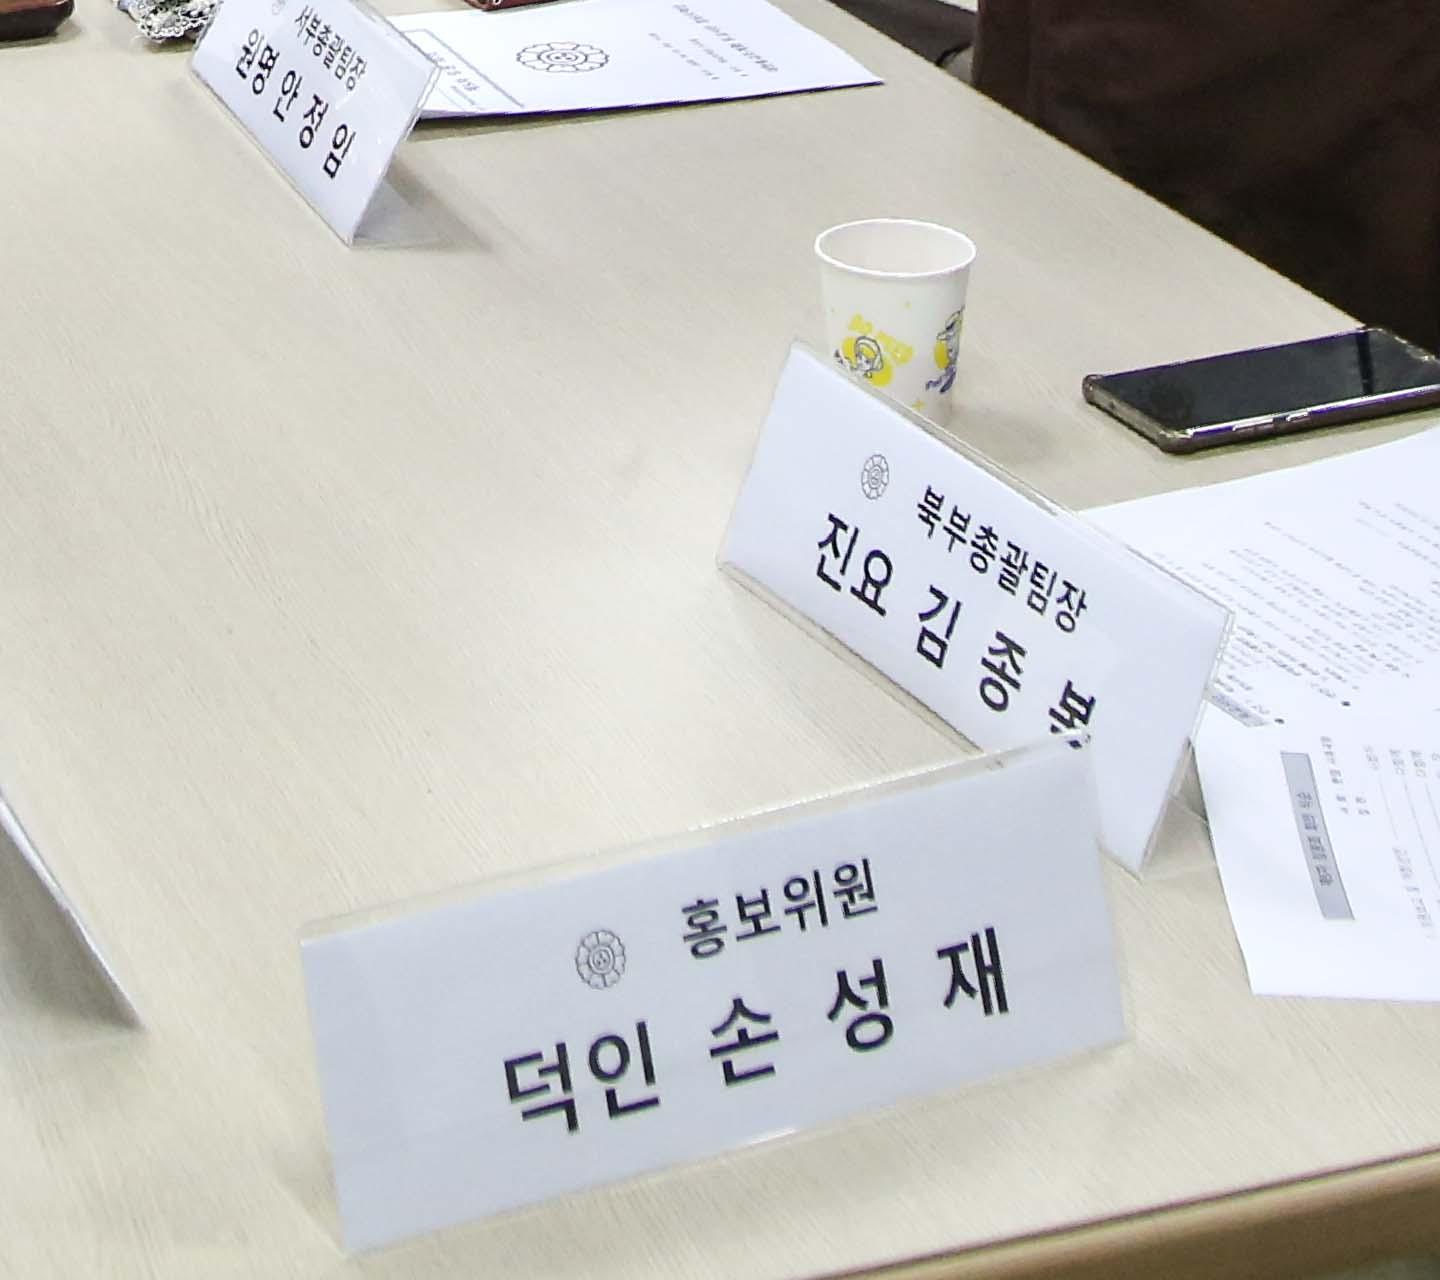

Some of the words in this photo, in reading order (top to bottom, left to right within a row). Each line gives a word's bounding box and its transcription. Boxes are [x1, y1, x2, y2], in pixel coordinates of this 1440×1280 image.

[235, 28, 280, 96] 원명
[273, 70, 303, 123] 안
[298, 94, 330, 150] 정
[323, 124, 357, 180] 임
[294, 4, 369, 91] 서부총괄팀장
[816, 512, 894, 617] 진요
[916, 584, 964, 669] 김
[978, 631, 1028, 713] 종
[916, 484, 1089, 634] 북부총괄팀장
[680, 856, 879, 960] 홍보위원
[502, 1019, 661, 1134] 덕인
[708, 995, 780, 1087] 손
[826, 957, 895, 1053] 성
[935, 926, 1010, 1017] 재
